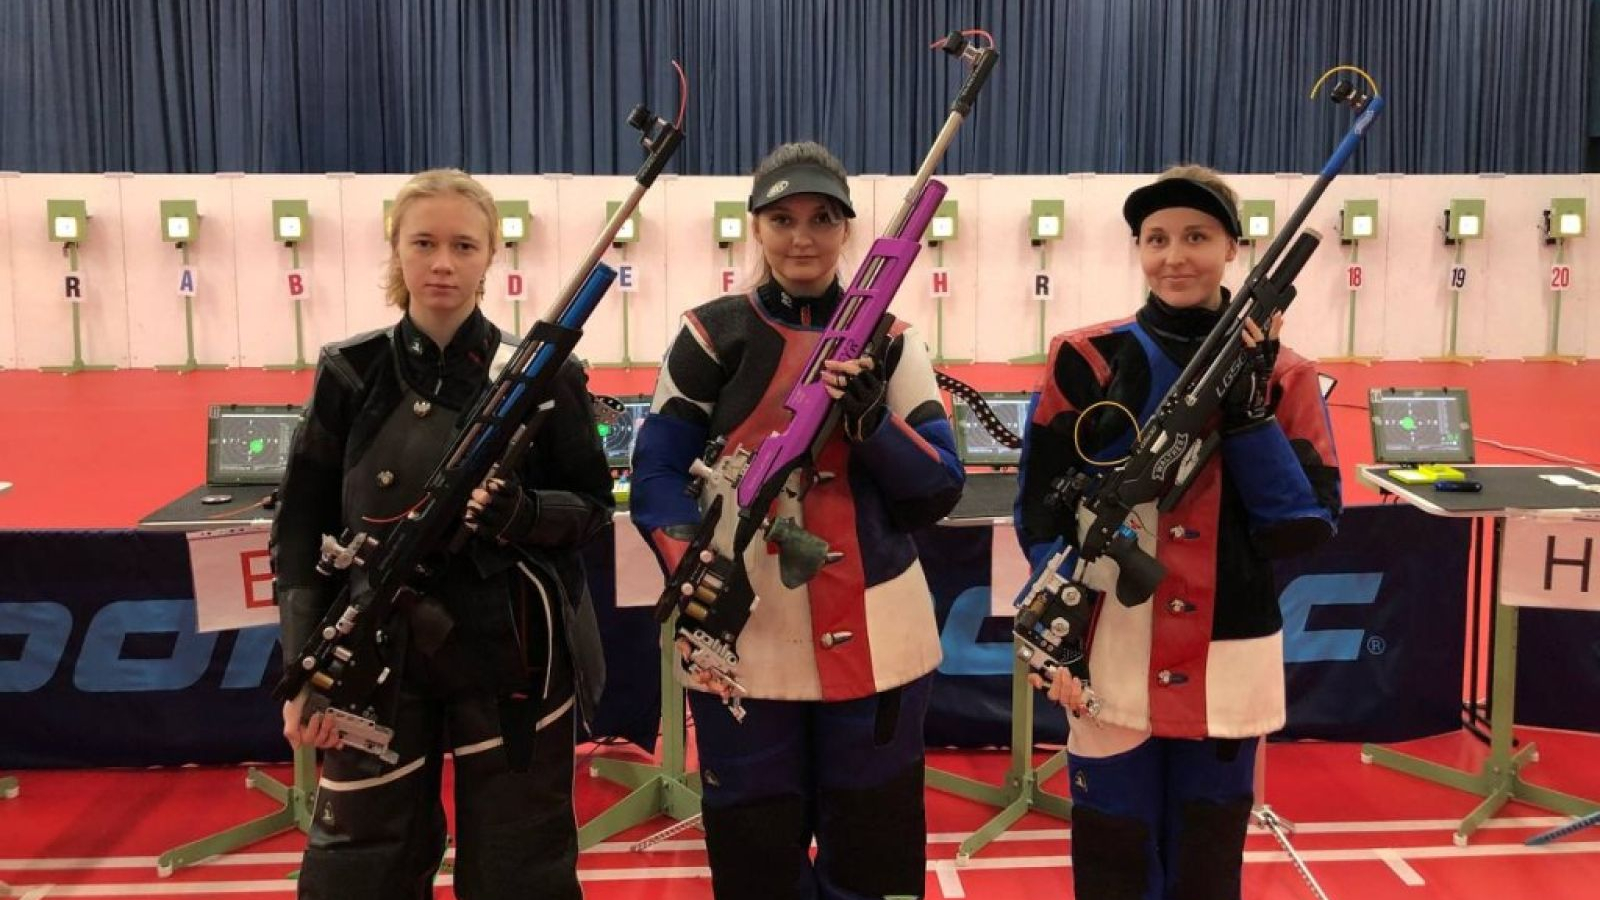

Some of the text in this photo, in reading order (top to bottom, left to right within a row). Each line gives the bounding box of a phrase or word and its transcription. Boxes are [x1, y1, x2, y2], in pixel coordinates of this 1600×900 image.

[65, 276, 81, 298] R
[180, 269, 194, 292] A
[288, 273, 304, 296] B
[507, 274, 523, 296] D
[619, 266, 632, 287] E
[722, 271, 735, 293] F
[932, 271, 948, 293] H
[1035, 274, 1050, 296] R
[1346, 266, 1363, 288] 18
[1450, 266, 1467, 289] 19
[1550, 266, 1570, 289] 20
[1543, 535, 1593, 593] H
